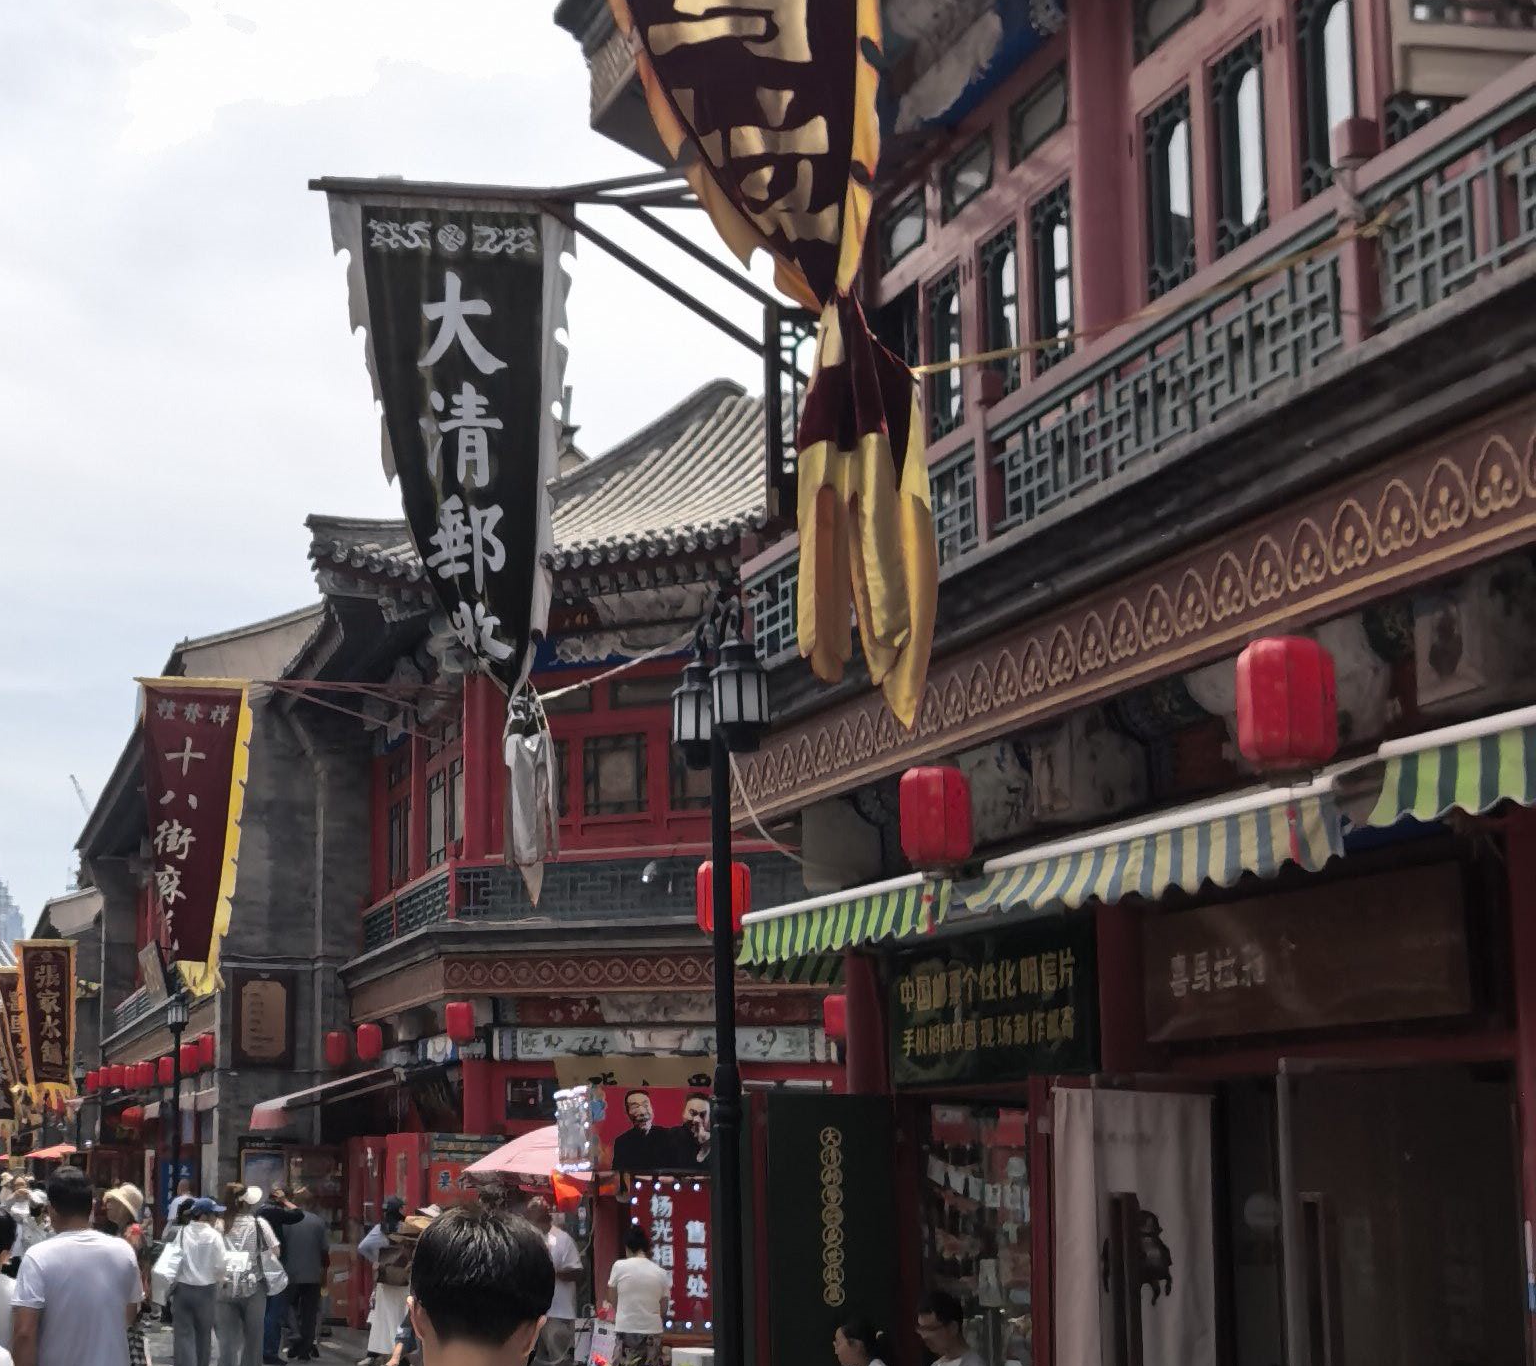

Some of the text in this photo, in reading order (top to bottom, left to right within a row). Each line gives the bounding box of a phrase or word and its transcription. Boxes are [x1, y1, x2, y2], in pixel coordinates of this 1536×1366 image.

[154, 736, 206, 953] 十八街麻
[650, 1193, 675, 1317] 杨光相
[685, 1220, 709, 1299] 售票处
